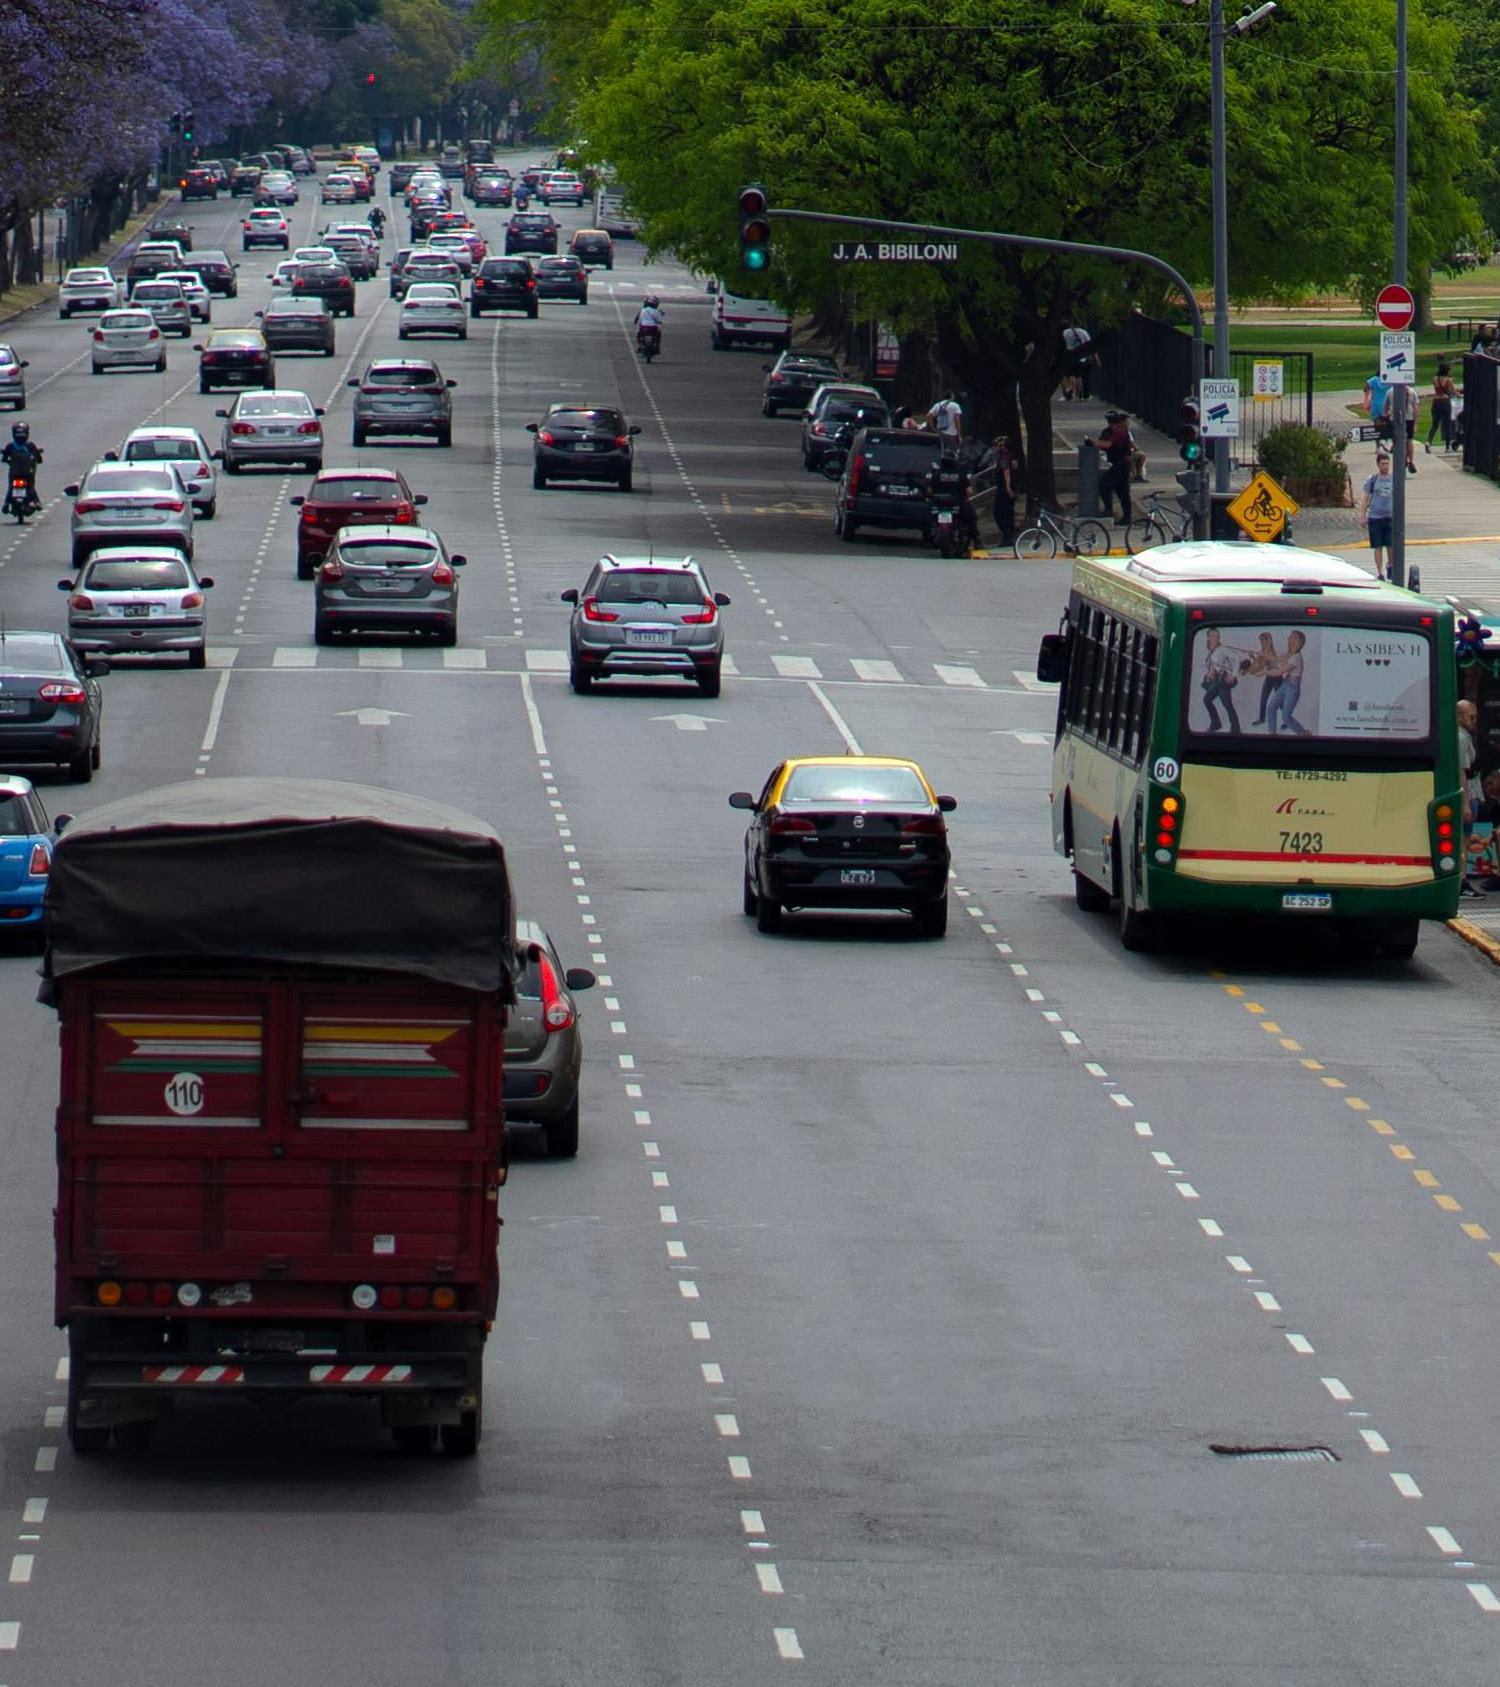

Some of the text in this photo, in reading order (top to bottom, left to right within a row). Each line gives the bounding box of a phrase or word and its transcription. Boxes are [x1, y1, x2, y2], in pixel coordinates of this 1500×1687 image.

[833, 244, 957, 260] J. A. BIBILONI
[1336, 642, 1362, 654] LAS
[1156, 762, 1175, 779] 60
[1295, 771, 1348, 782] 4729-4292
[1279, 831, 1323, 854] 7423
[169, 1080, 202, 1107] 110
